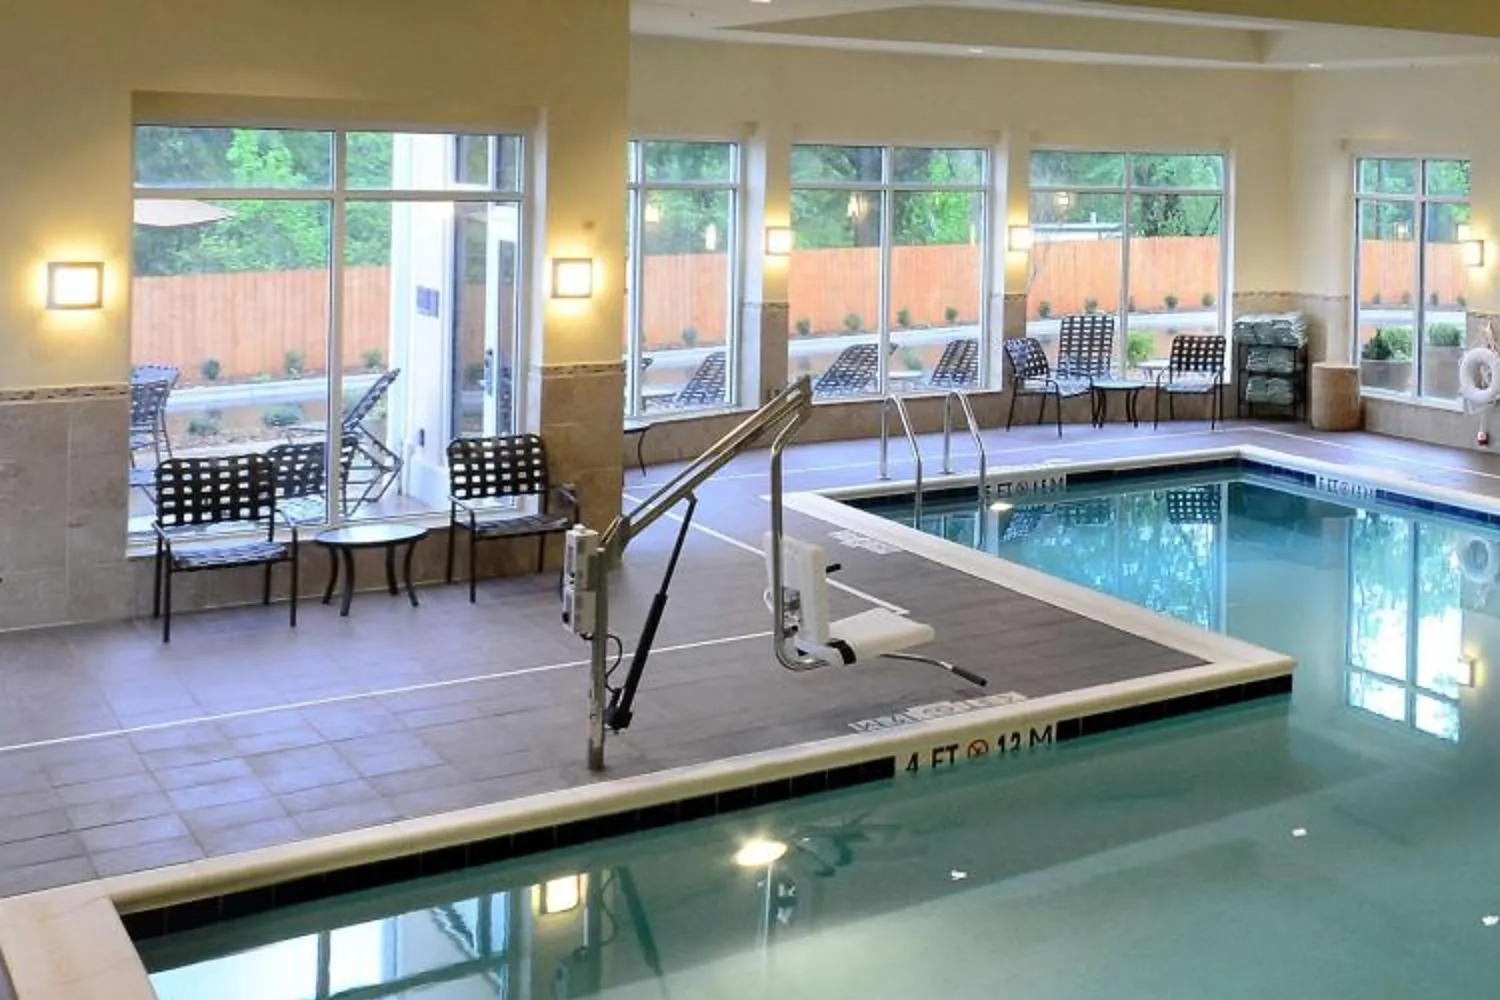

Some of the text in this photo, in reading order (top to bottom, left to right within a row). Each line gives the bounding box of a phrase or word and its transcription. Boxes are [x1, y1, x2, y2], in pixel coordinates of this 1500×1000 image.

[906, 752, 918, 773] 4
[932, 744, 958, 769] FT
[1030, 725, 1052, 748] M
